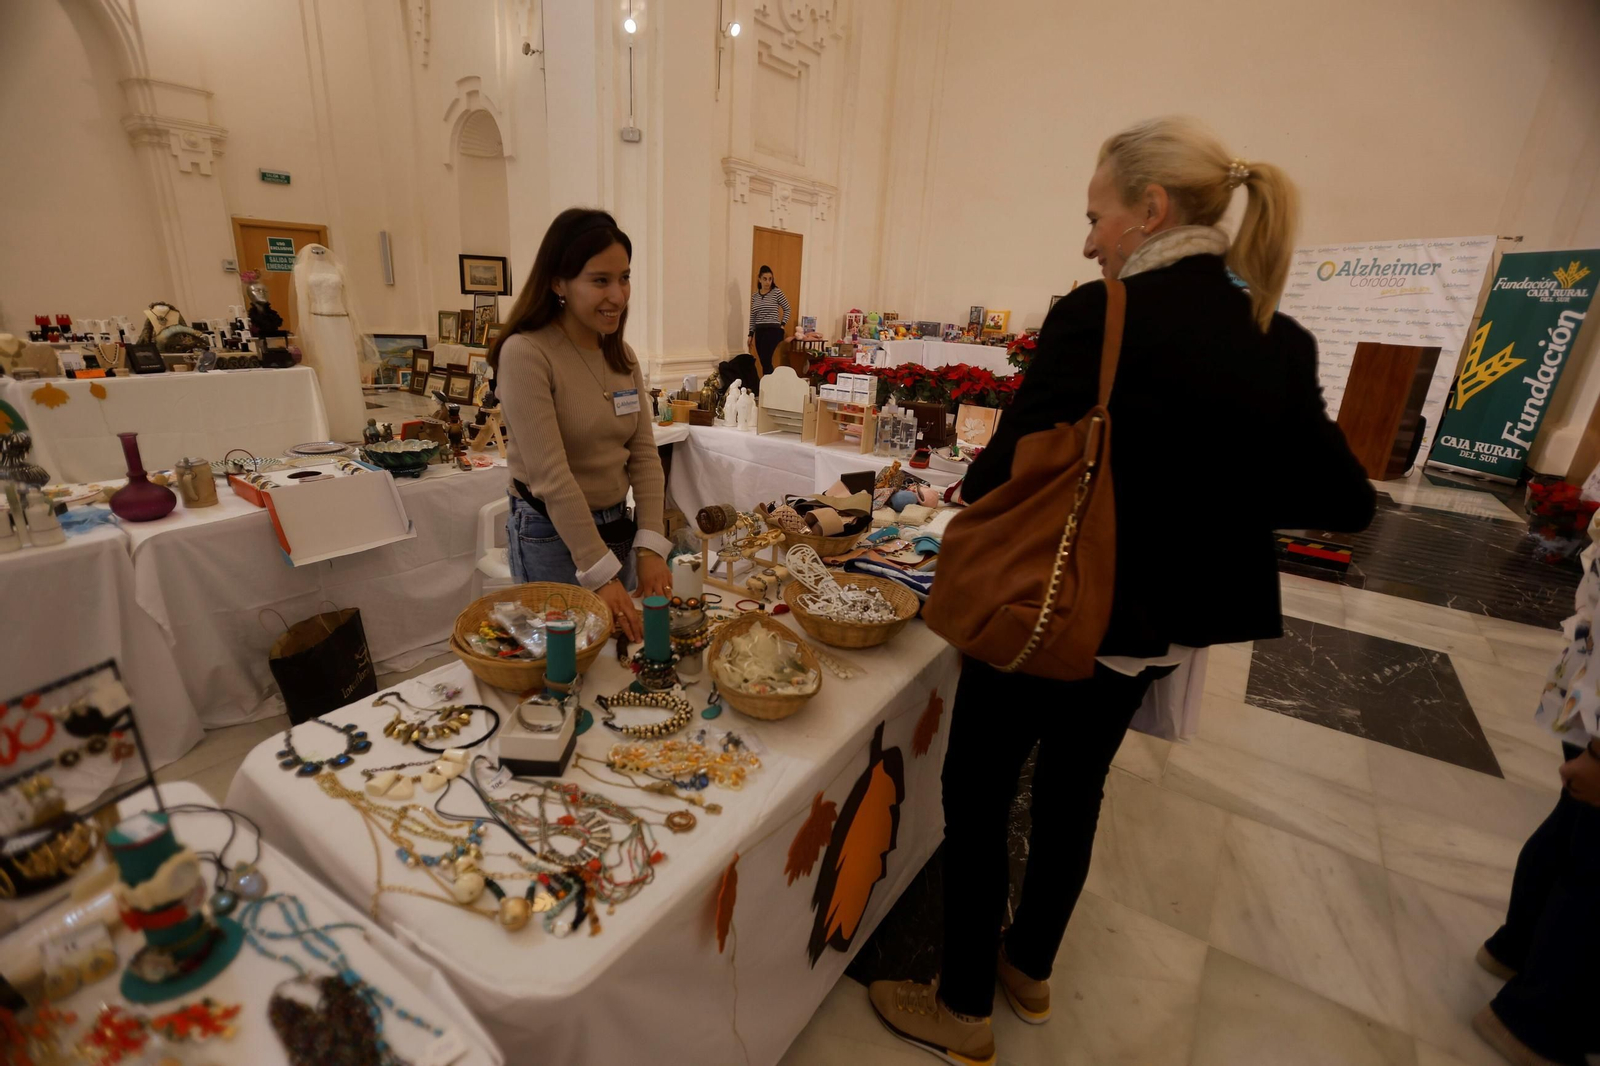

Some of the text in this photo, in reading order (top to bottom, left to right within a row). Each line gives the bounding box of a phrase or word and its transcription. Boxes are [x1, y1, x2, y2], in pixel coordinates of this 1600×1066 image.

[1335, 257, 1442, 276] Alzheimer
[1493, 277, 1558, 291] Fundación
[1526, 288, 1589, 297] CAJA RURAL
[1501, 309, 1588, 451] Fundación
[1440, 435, 1522, 460] CAJA RURAL
[1459, 450, 1498, 464] DEL SUR
